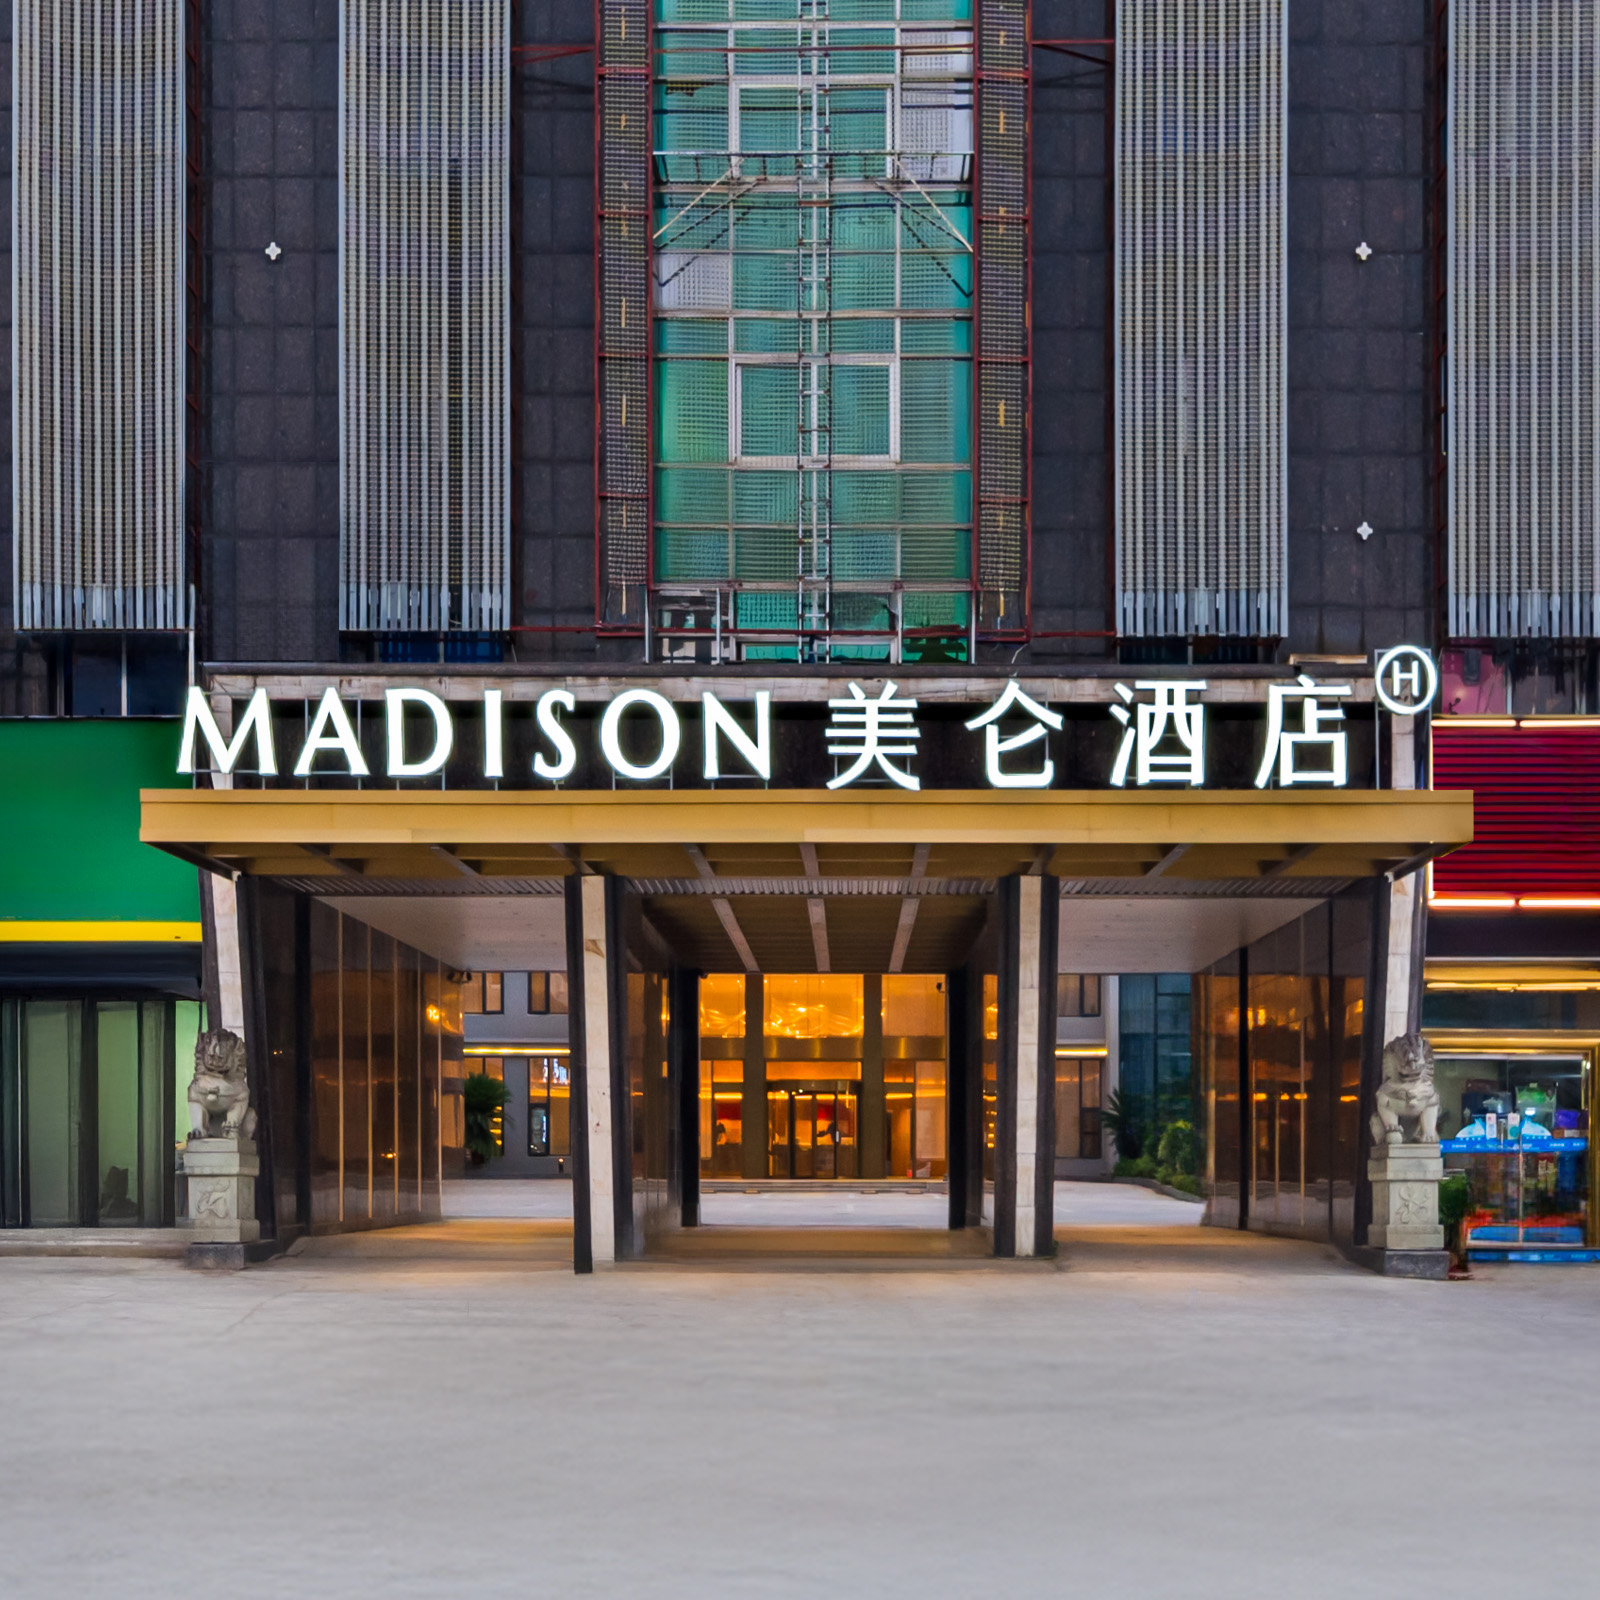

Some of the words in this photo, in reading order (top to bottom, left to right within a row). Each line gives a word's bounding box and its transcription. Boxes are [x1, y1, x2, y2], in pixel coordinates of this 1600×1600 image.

[176, 686, 772, 779] MADISON
[825, 675, 1352, 791] 美仑酒店
